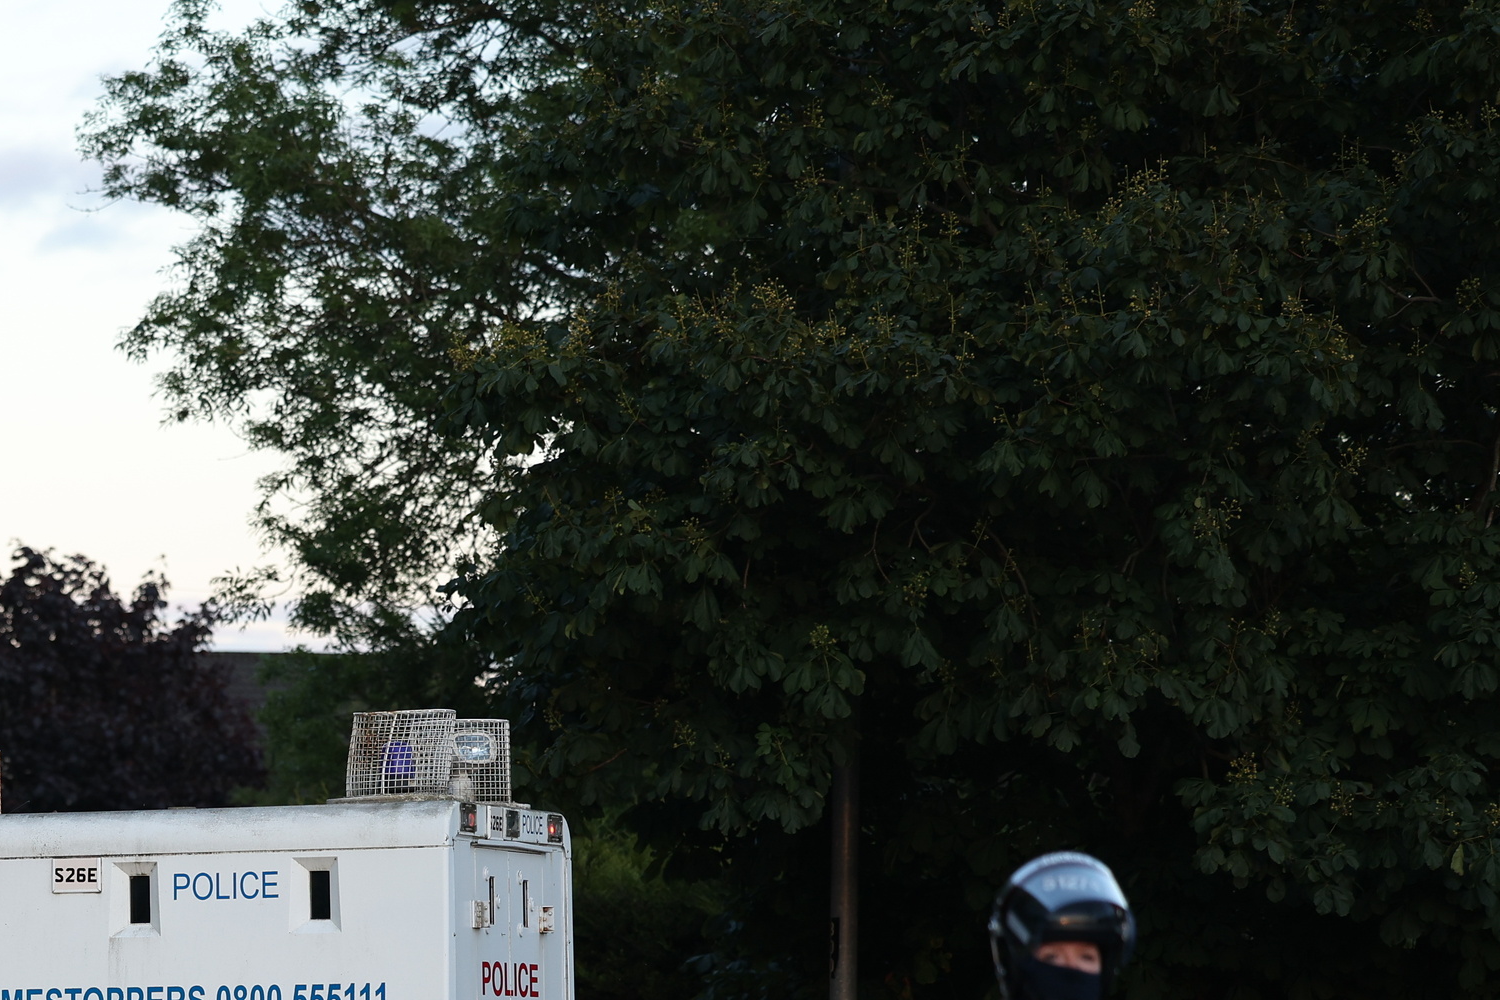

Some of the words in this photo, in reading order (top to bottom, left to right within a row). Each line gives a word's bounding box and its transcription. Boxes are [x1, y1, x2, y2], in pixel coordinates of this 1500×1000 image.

[522, 814, 543, 835] POLICE
[55, 867, 98, 883] S26E
[173, 870, 279, 901] POLICE
[482, 960, 539, 998] POLICE
